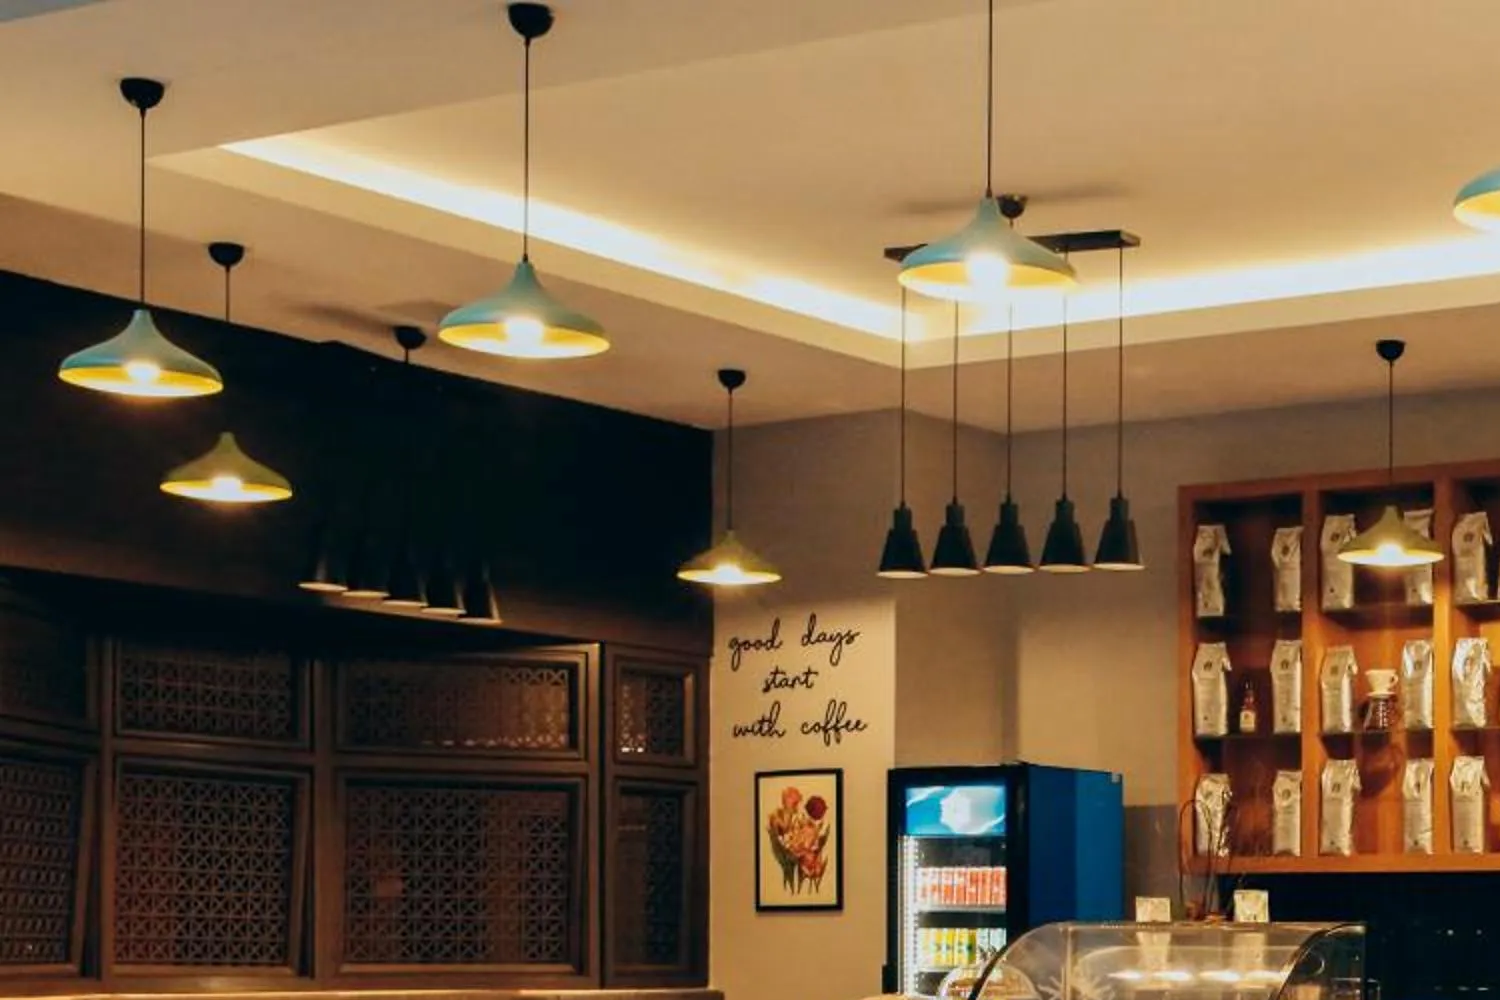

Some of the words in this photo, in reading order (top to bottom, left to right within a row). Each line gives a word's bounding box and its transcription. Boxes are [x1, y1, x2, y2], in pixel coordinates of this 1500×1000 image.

[728, 617, 784, 672] good
[801, 613, 861, 667] days
[762, 665, 819, 693] start
[733, 700, 786, 738] with
[800, 699, 868, 747] coffee
